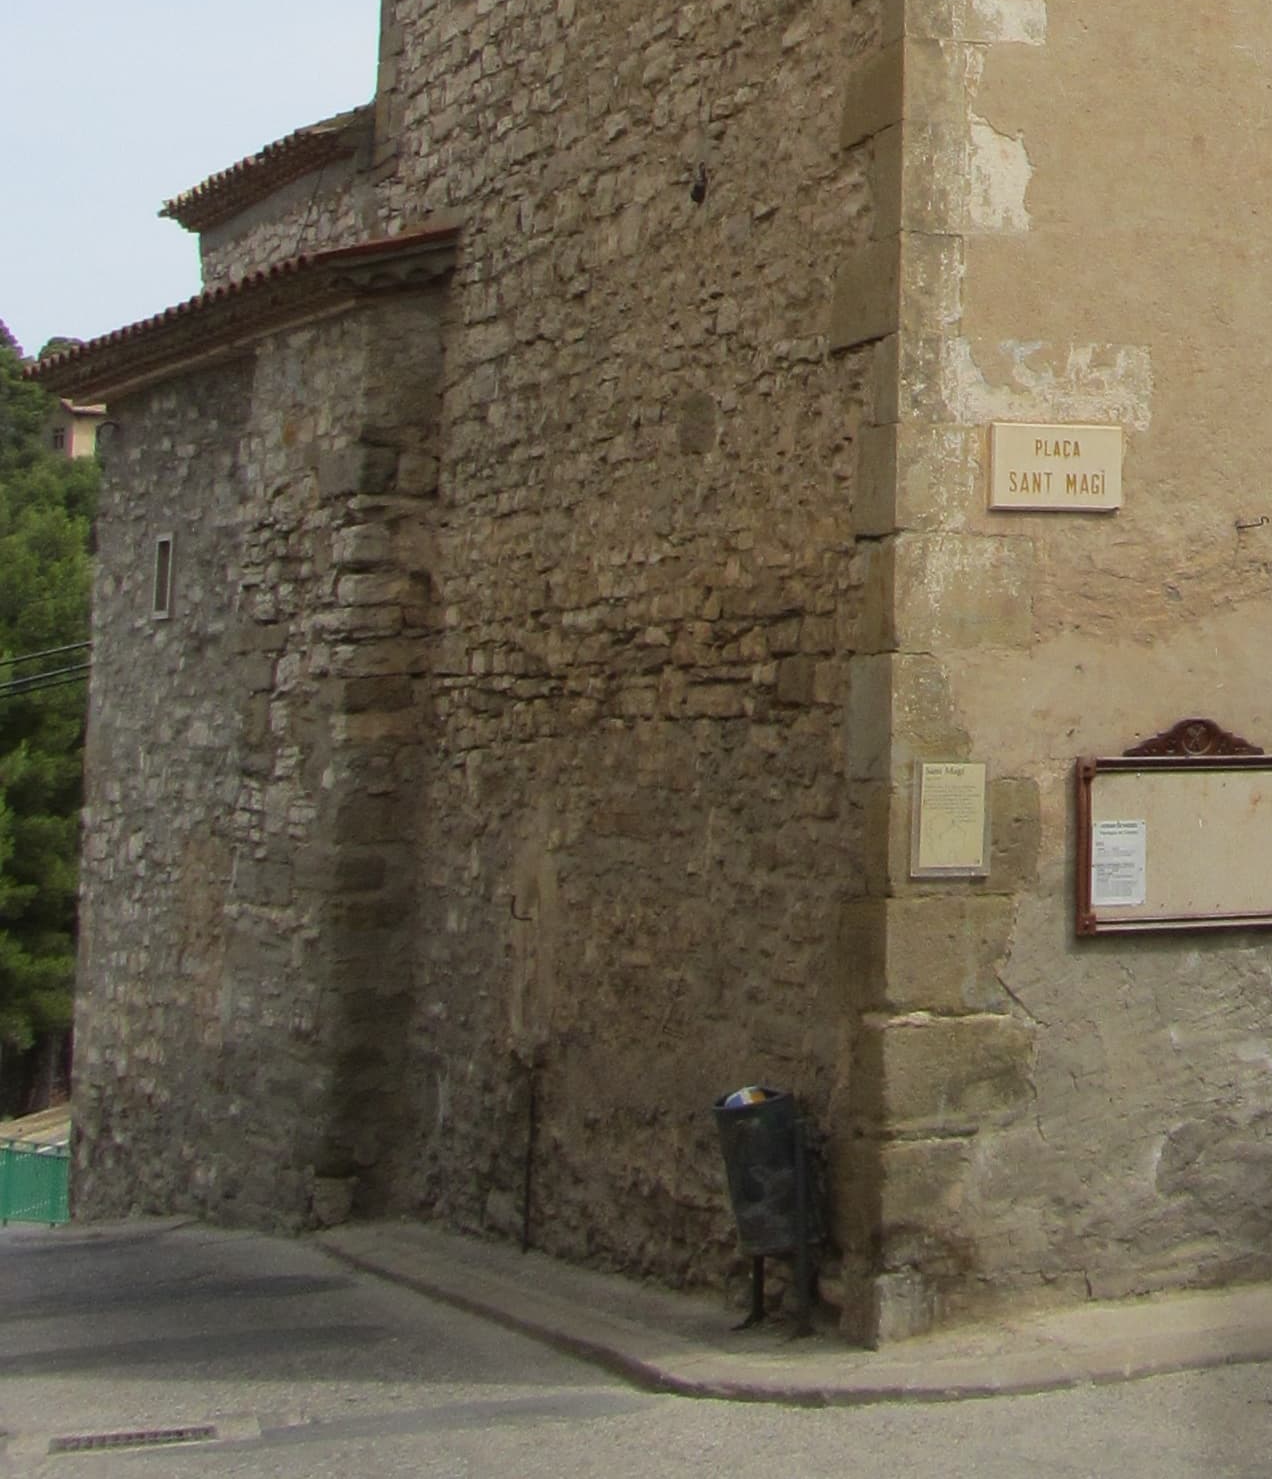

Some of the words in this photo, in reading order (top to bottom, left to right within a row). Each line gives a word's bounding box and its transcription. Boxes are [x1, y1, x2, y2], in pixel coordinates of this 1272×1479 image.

[1035, 439, 1081, 459] PLAÇA
[1009, 471, 1053, 493] SANT
[1066, 470, 1105, 495] MAGÍ
